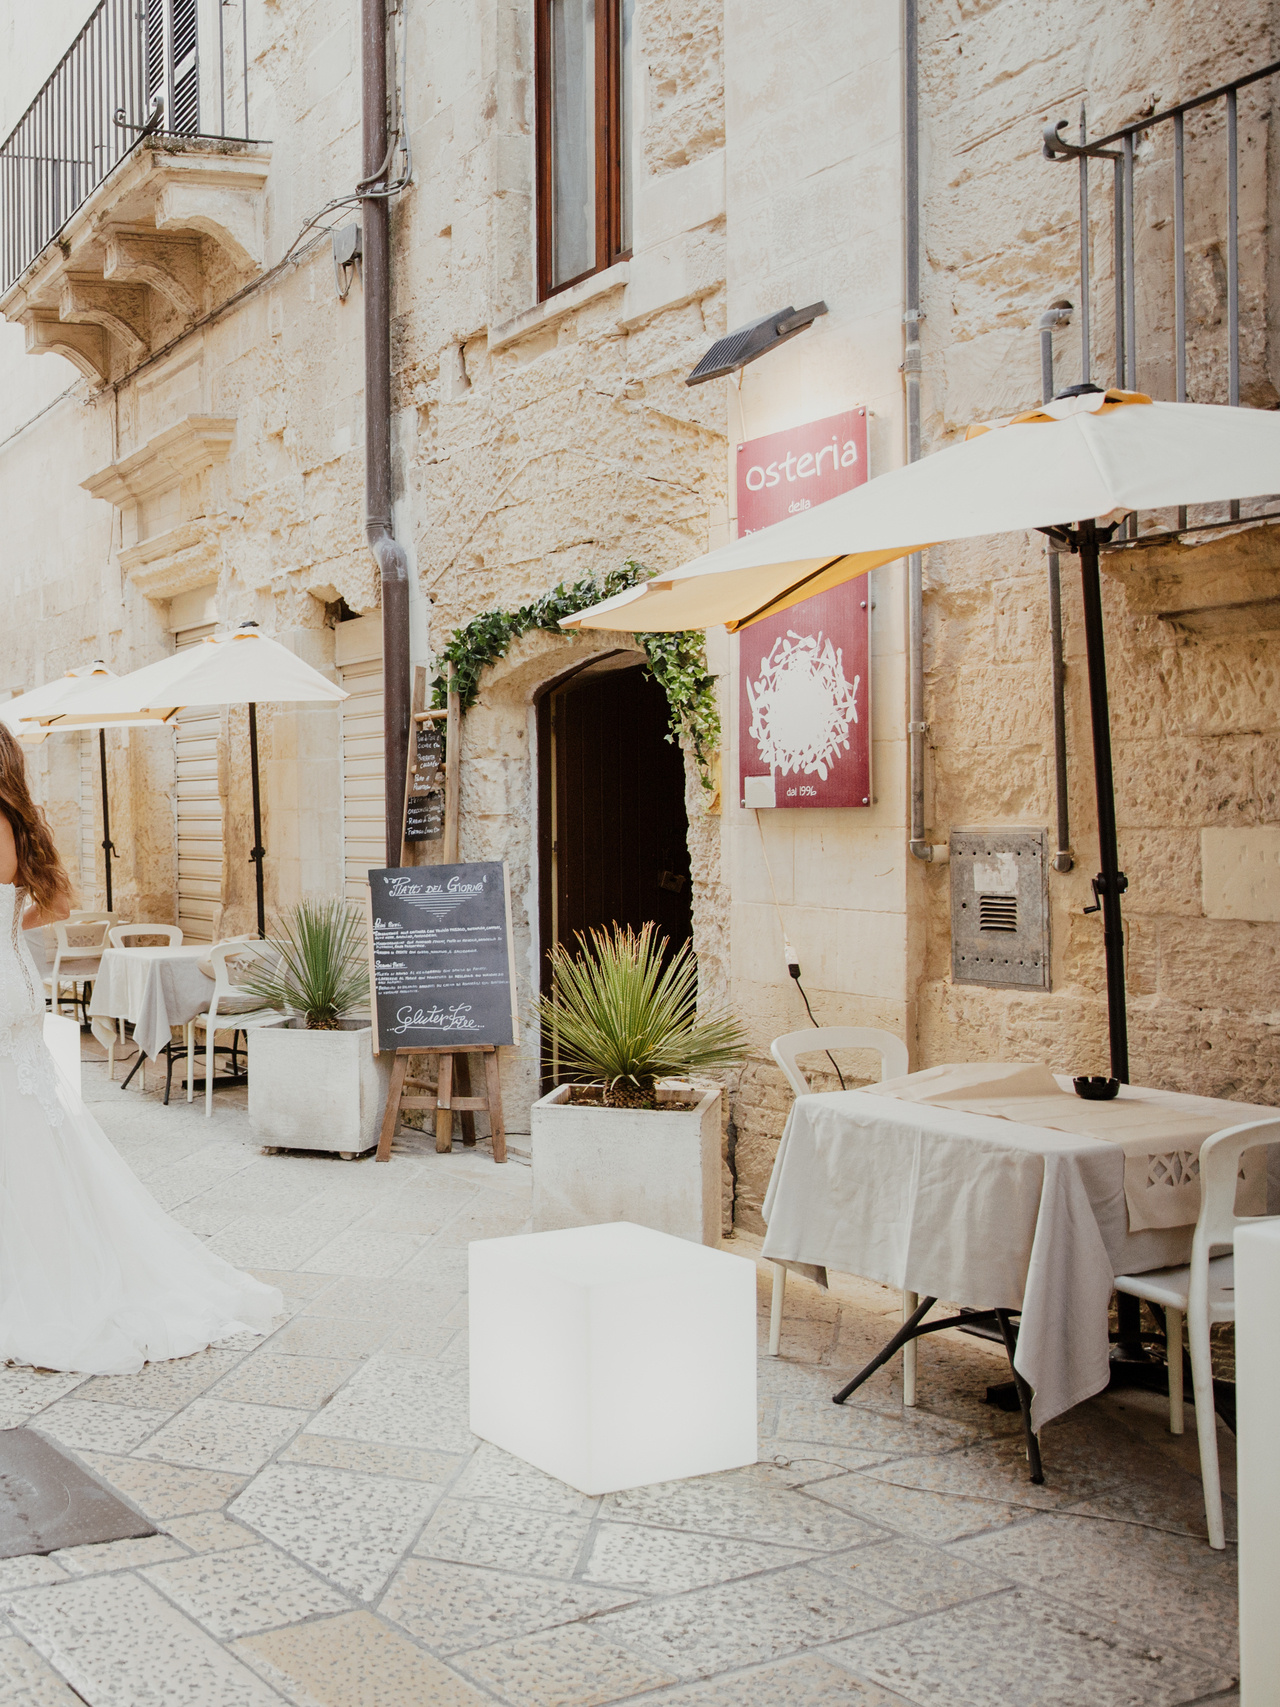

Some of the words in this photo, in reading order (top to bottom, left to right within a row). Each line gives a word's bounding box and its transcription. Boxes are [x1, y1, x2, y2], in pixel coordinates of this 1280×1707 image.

[746, 435, 858, 491] osteria
[788, 498, 811, 513] della
[786, 787, 797, 796] dal
[799, 785, 817, 796] 1996
